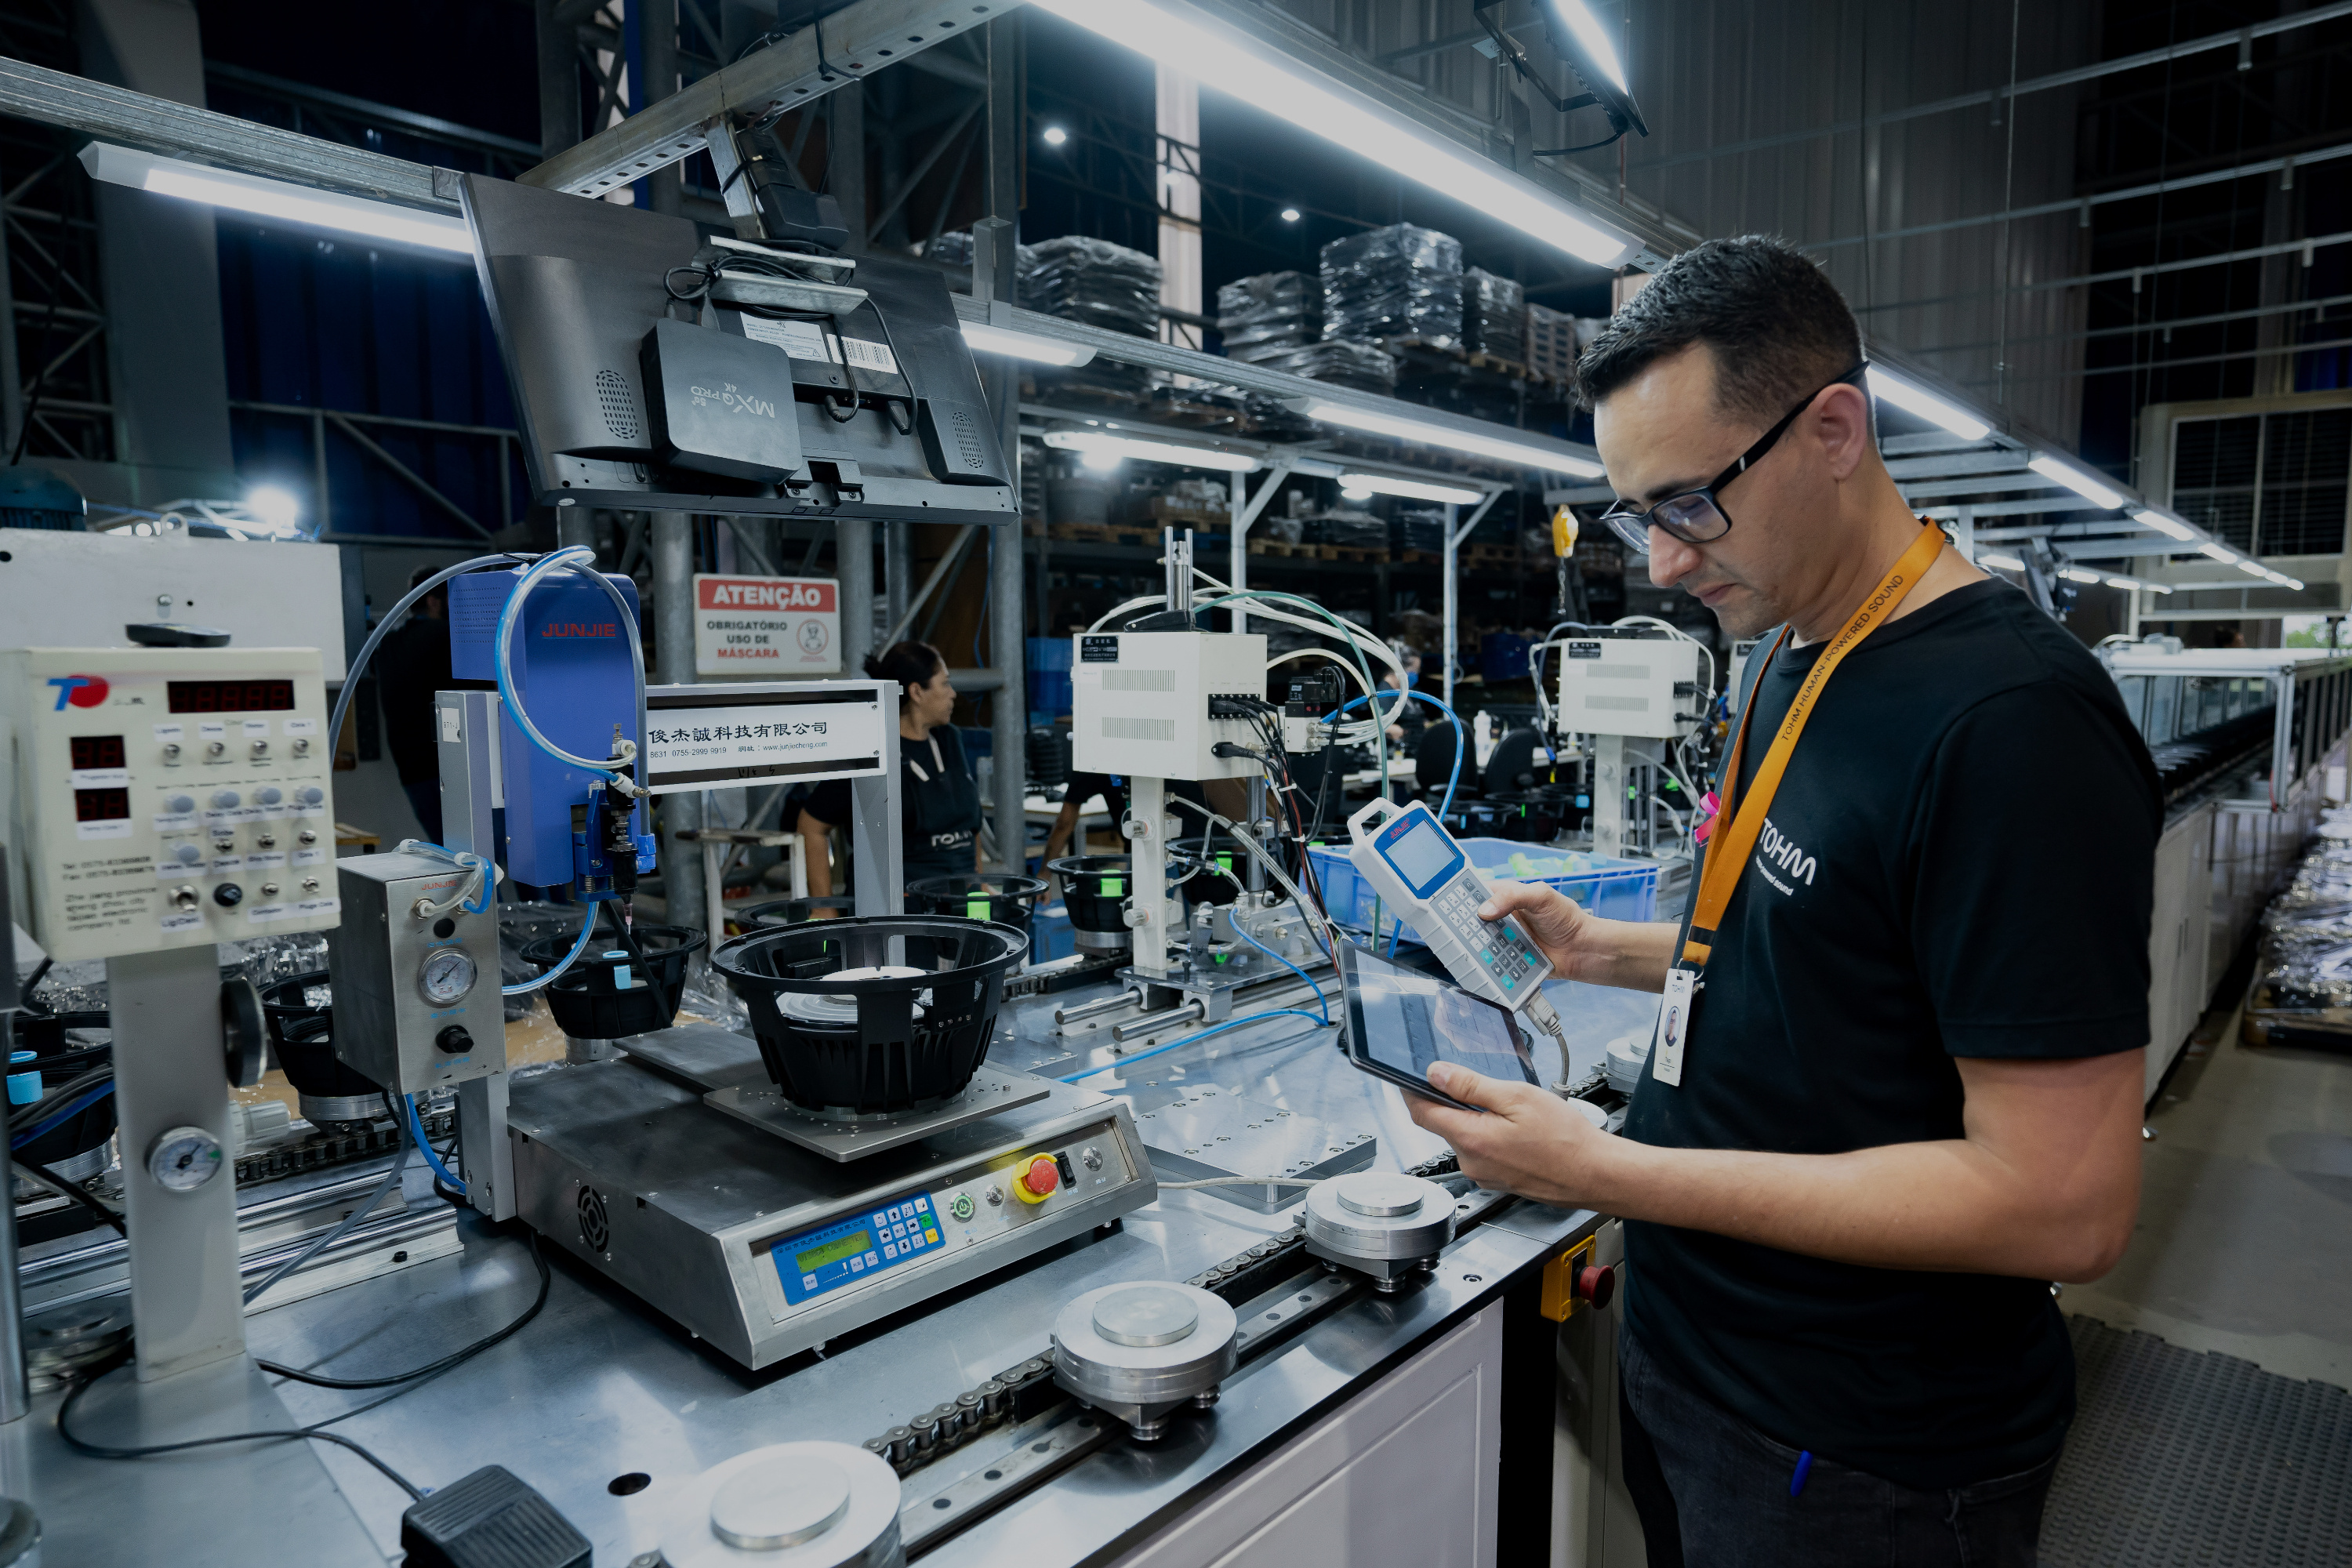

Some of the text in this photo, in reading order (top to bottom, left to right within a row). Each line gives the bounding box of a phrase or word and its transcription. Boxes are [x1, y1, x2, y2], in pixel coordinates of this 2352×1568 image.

[691, 386, 720, 400] PRO
[724, 383, 737, 393] 4K
[713, 584, 822, 610] ATENÇÃO
[542, 623, 615, 637] JUNJIE
[707, 619, 788, 631] OBRIGATÓRIO
[727, 634, 770, 644] USO DE
[717, 646, 780, 659] MÁSCARA
[1781, 708, 1802, 741] TOHM
[1868, 575, 1904, 613] SOUND
[1390, 819, 1410, 840] JUNJIE
[1759, 817, 1817, 886] TOHM
[421, 880, 457, 891] JUNJIE
